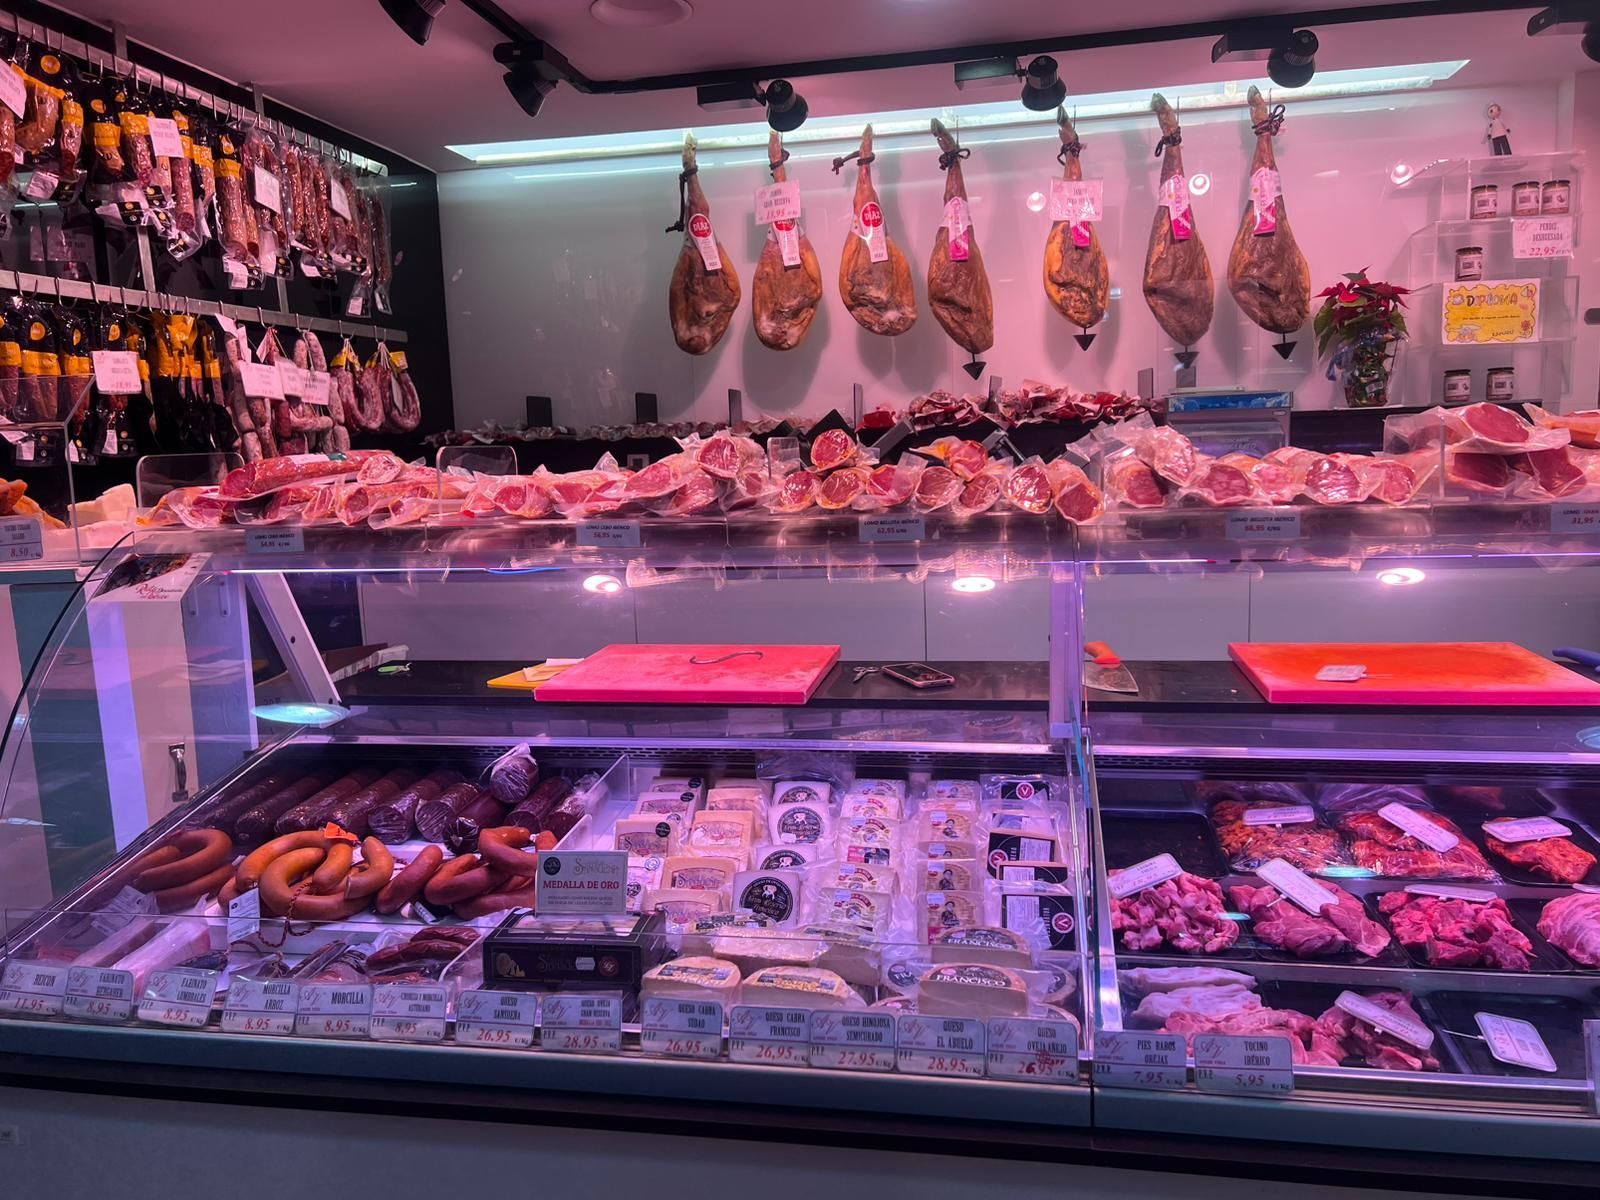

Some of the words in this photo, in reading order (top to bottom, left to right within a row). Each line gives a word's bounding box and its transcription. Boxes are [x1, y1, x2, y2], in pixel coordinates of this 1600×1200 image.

[543, 880, 585, 890] MEDALLA
[587, 880, 599, 890] DE
[600, 880, 620, 890] ORO
[935, 974, 1007, 986] FRANCISCO
[262, 983, 291, 996] MORCILLA
[264, 999, 284, 1010] ARROZ
[331, 991, 364, 1005] MORCILLA
[163, 1008, 191, 1022] 8.95
[765, 1012, 784, 1022] QUESO
[786, 1013, 806, 1024] CABRA
[244, 1018, 270, 1031] 8.95
[323, 1019, 351, 1032] 8.95
[841, 1016, 860, 1027] QUESO
[862, 1017, 890, 1028] HINOJOSA
[943, 1021, 964, 1033] QUESO
[476, 1028, 512, 1042] 26.95
[769, 1026, 800, 1037] FRANCISCO
[846, 1031, 883, 1042] SEMICURADO
[1037, 1026, 1057, 1039] QUESO
[562, 1035, 599, 1048] 28.95
[664, 1039, 701, 1053] 26.95
[936, 1036, 946, 1048] EL
[948, 1037, 973, 1049] ABUELO
[1137, 1039, 1152, 1051] PIES
[1244, 1040, 1268, 1052] TOCINO
[755, 1045, 793, 1060] 26.95
[837, 1052, 876, 1066] 27.95
[927, 1056, 966, 1072] 28.95
[1144, 1054, 1168, 1065] OREJAS
[1244, 1054, 1271, 1066] IBÉRICO
[1133, 1070, 1164, 1084] 7.95
[1234, 1073, 1265, 1087] 5.95
